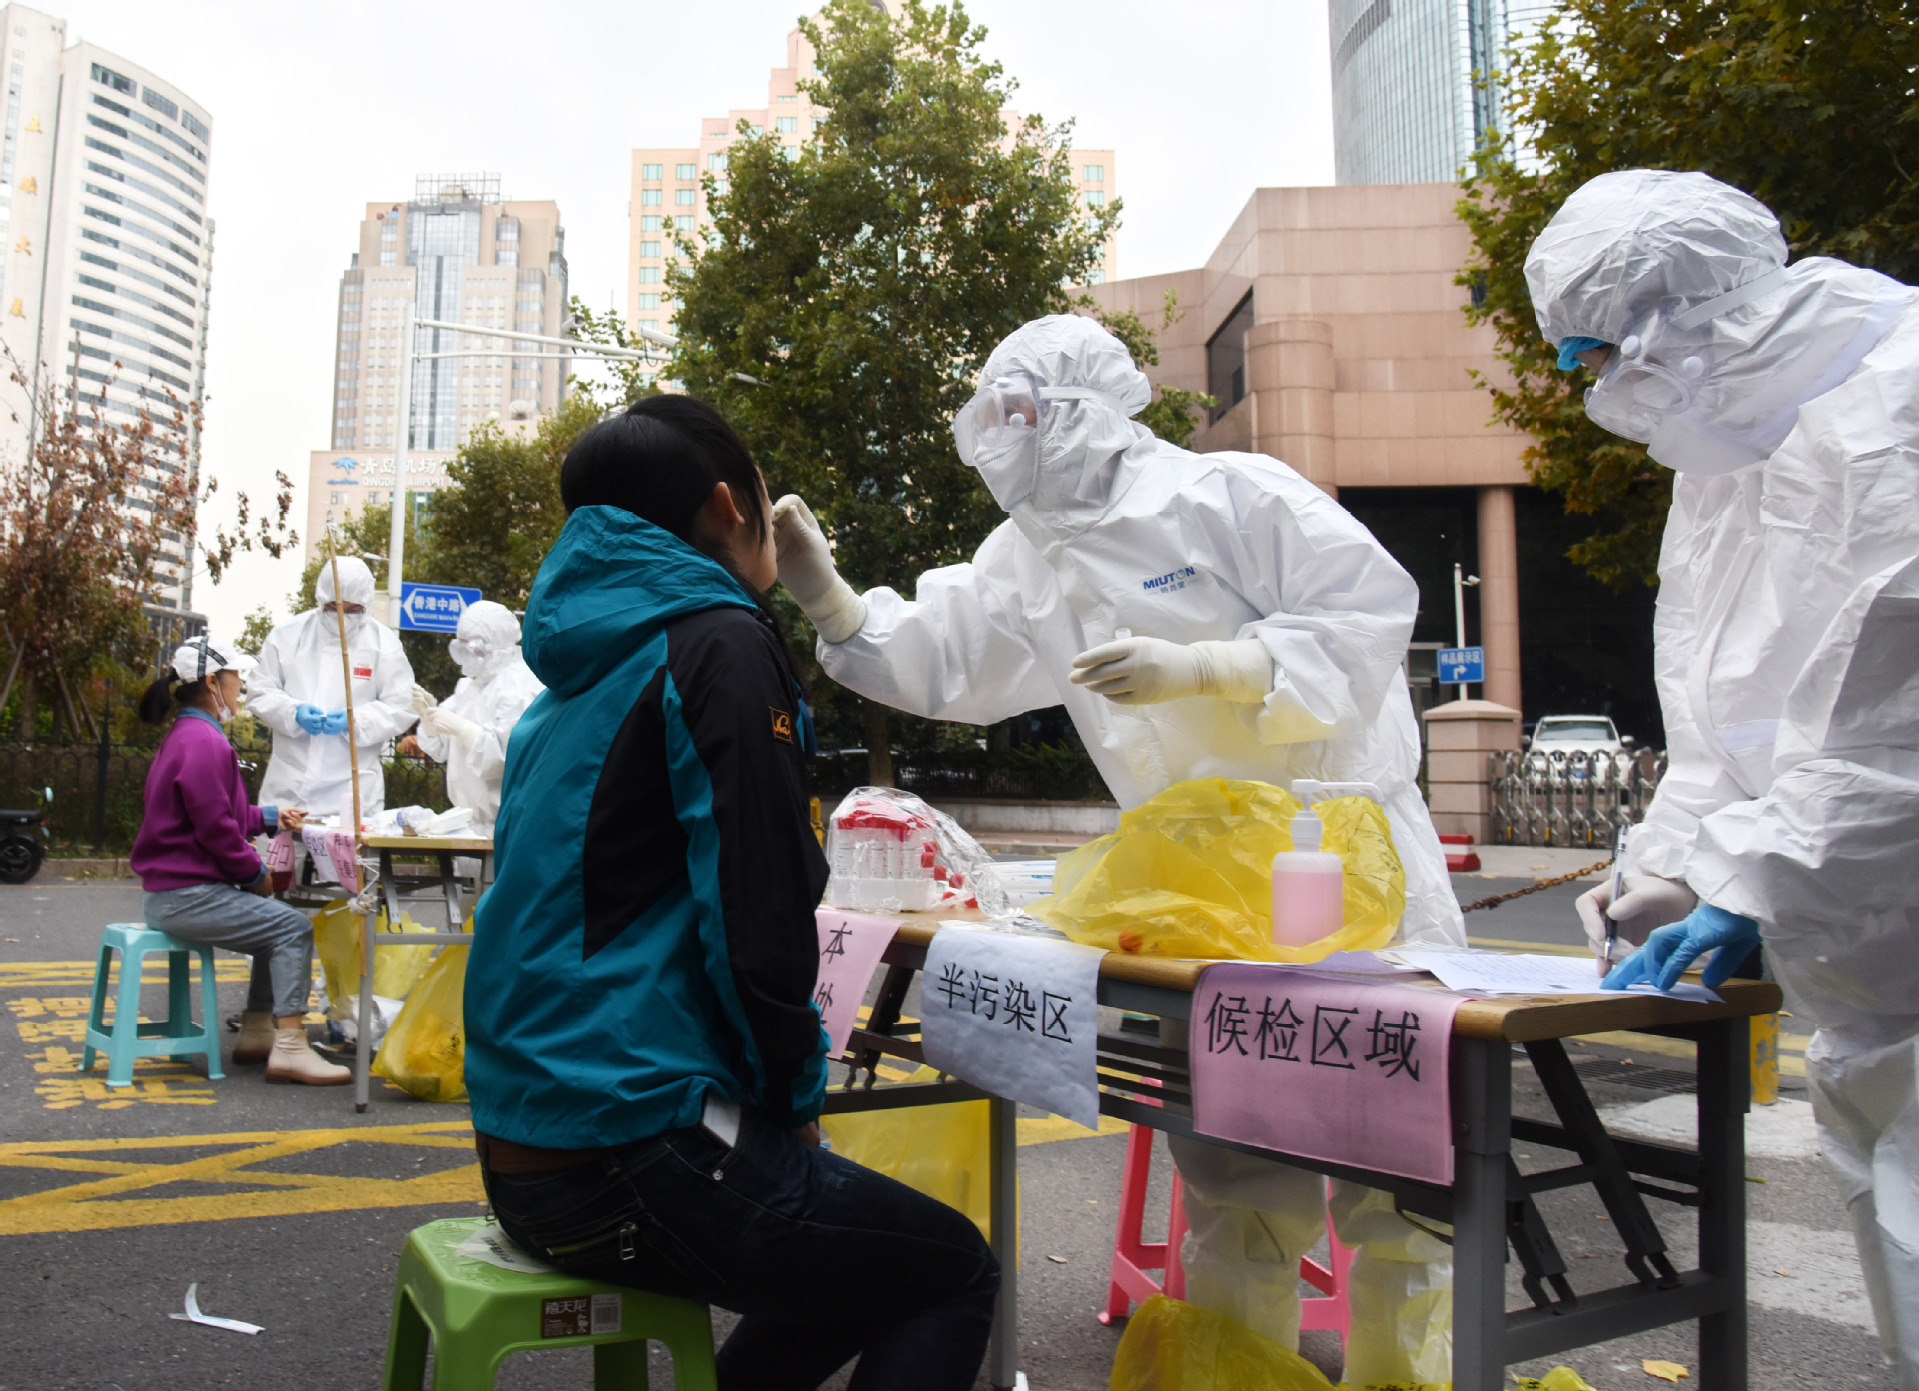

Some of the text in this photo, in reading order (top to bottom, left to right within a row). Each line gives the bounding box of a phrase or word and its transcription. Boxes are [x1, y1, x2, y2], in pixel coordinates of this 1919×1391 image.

[414, 595, 460, 612] 香港中路
[1441, 651, 1481, 666] 样品展示区
[821, 921, 853, 964] 本
[937, 962, 1074, 1044] 半污染区
[1205, 990, 1422, 1082] 候检区域
